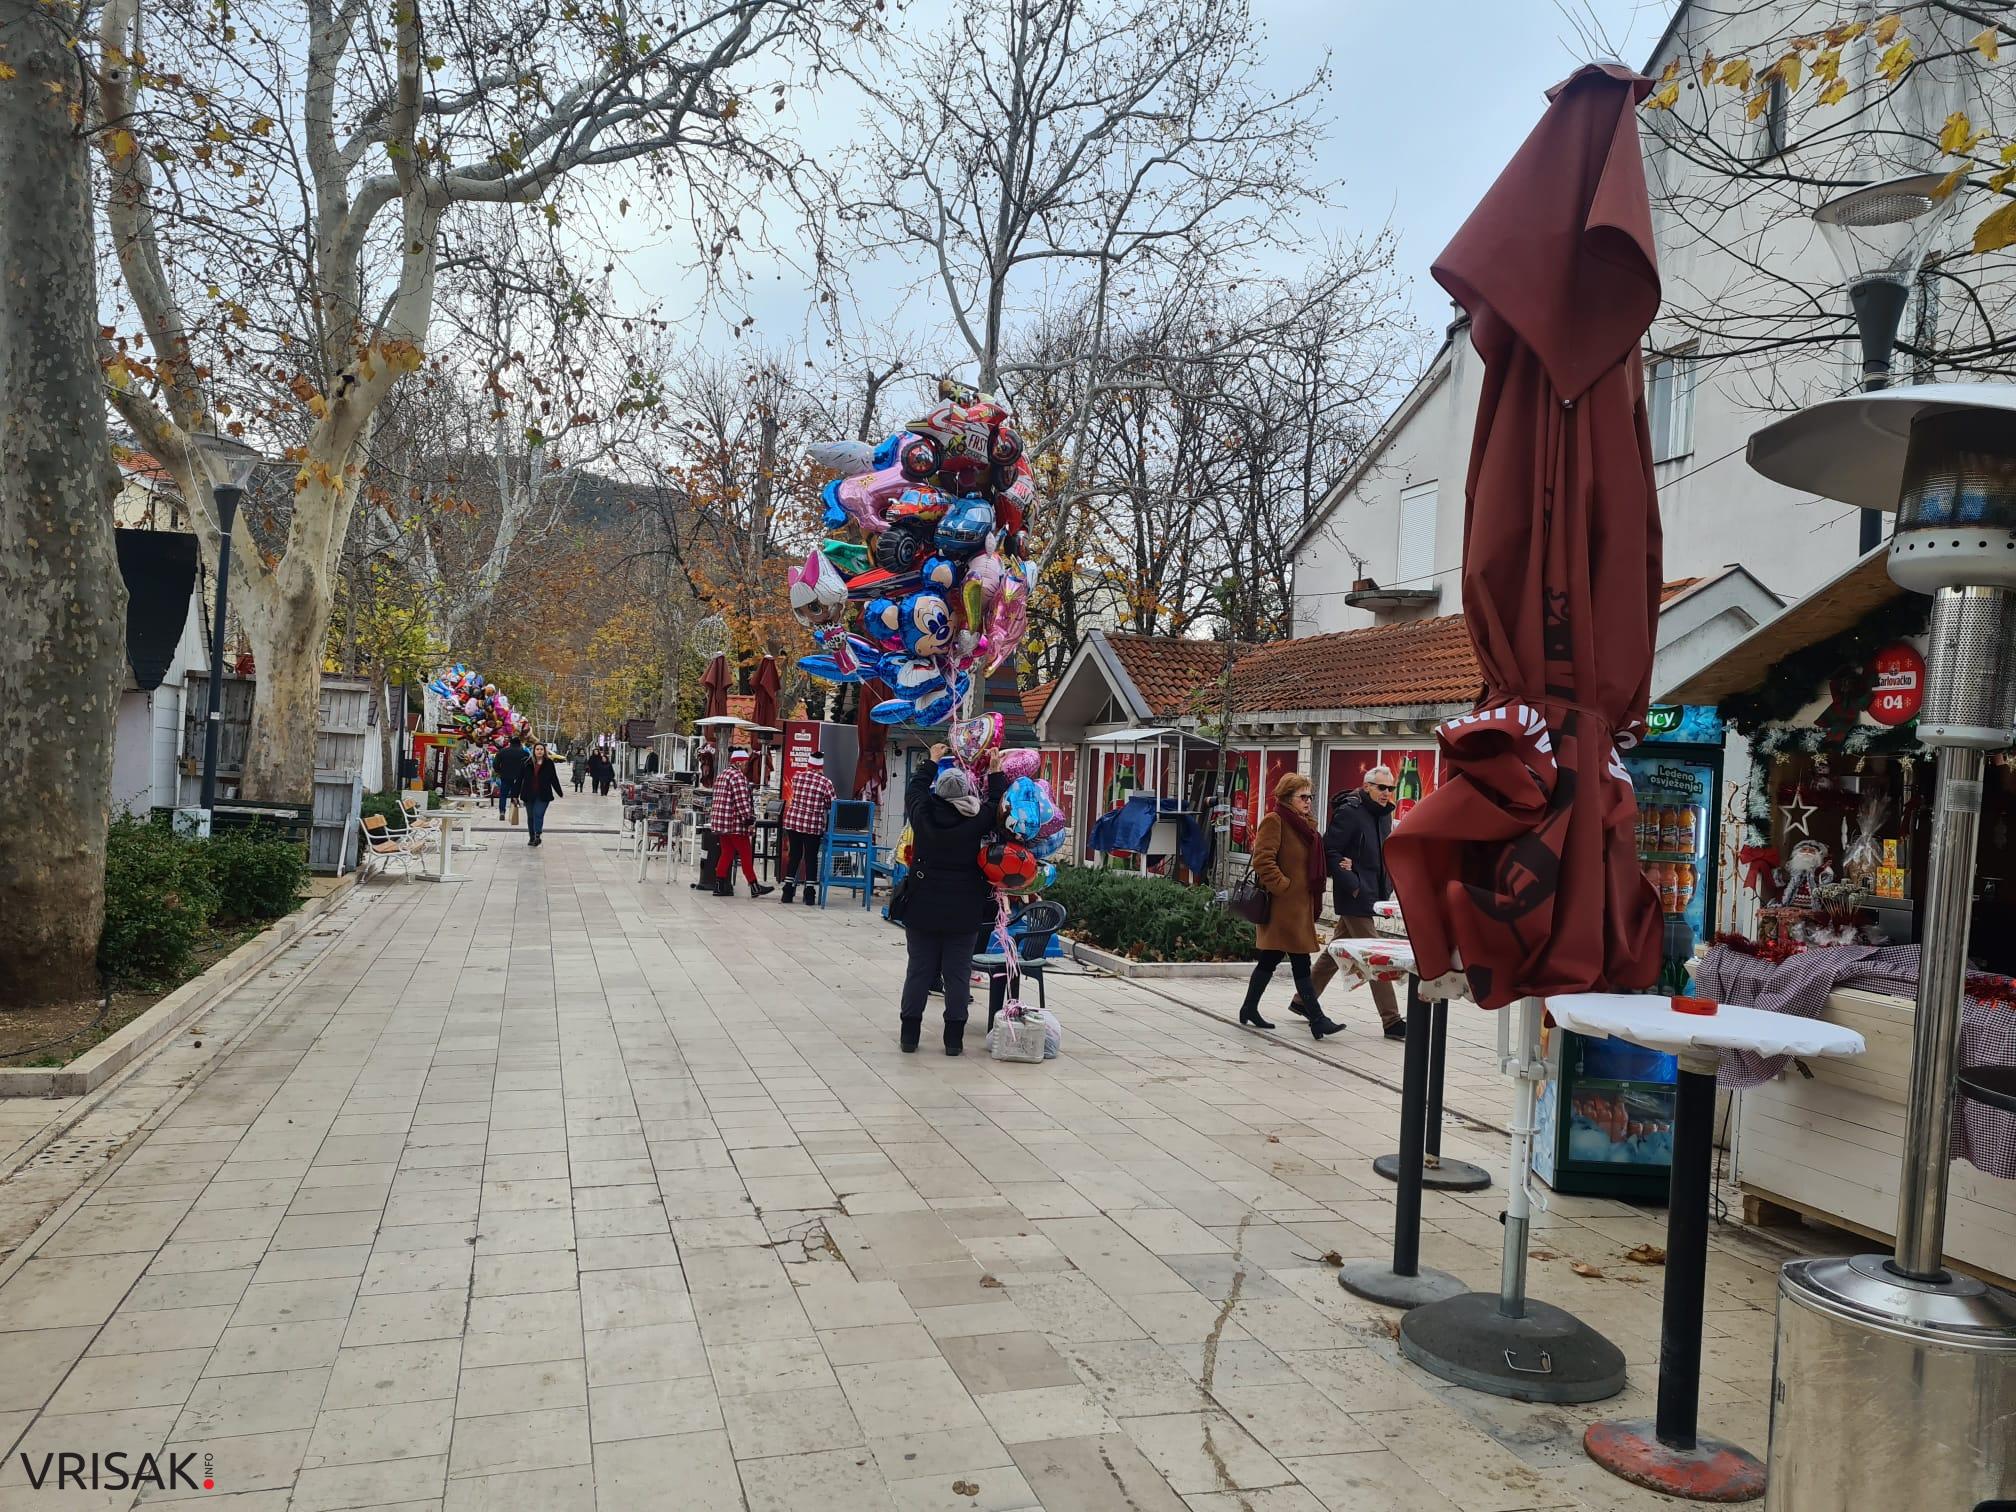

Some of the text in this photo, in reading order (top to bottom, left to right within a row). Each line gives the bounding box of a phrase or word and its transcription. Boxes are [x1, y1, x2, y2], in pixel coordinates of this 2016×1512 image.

[1882, 694, 1904, 710] 04
[1646, 711, 1675, 728] icy
[1659, 765, 1694, 781] Ledeno
[1650, 775, 1703, 793] osvježenje!
